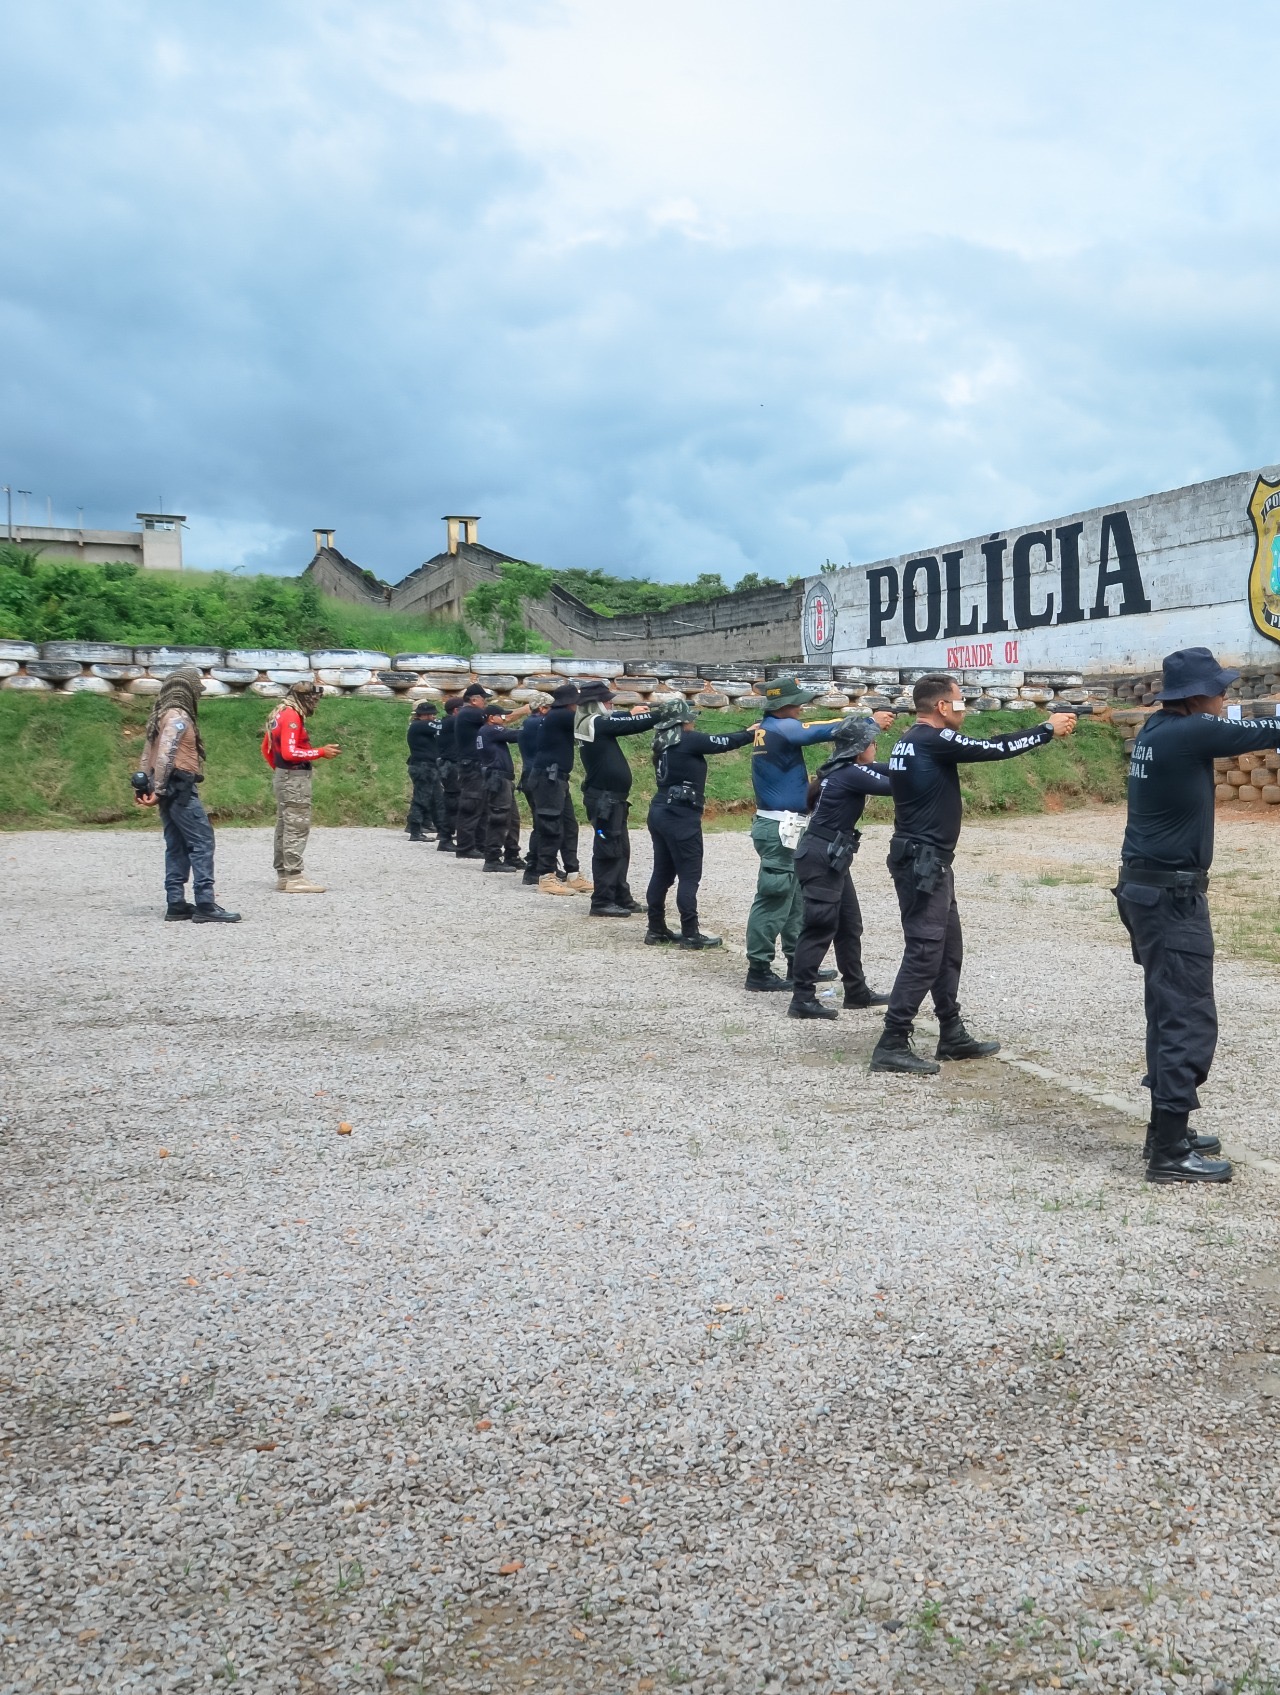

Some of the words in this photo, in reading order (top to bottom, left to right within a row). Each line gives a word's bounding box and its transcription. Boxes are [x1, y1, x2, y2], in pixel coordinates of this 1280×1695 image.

[866, 511, 1152, 648] POLÍCIA
[947, 644, 993, 669] ESTANDE
[1004, 640, 1019, 664] 01
